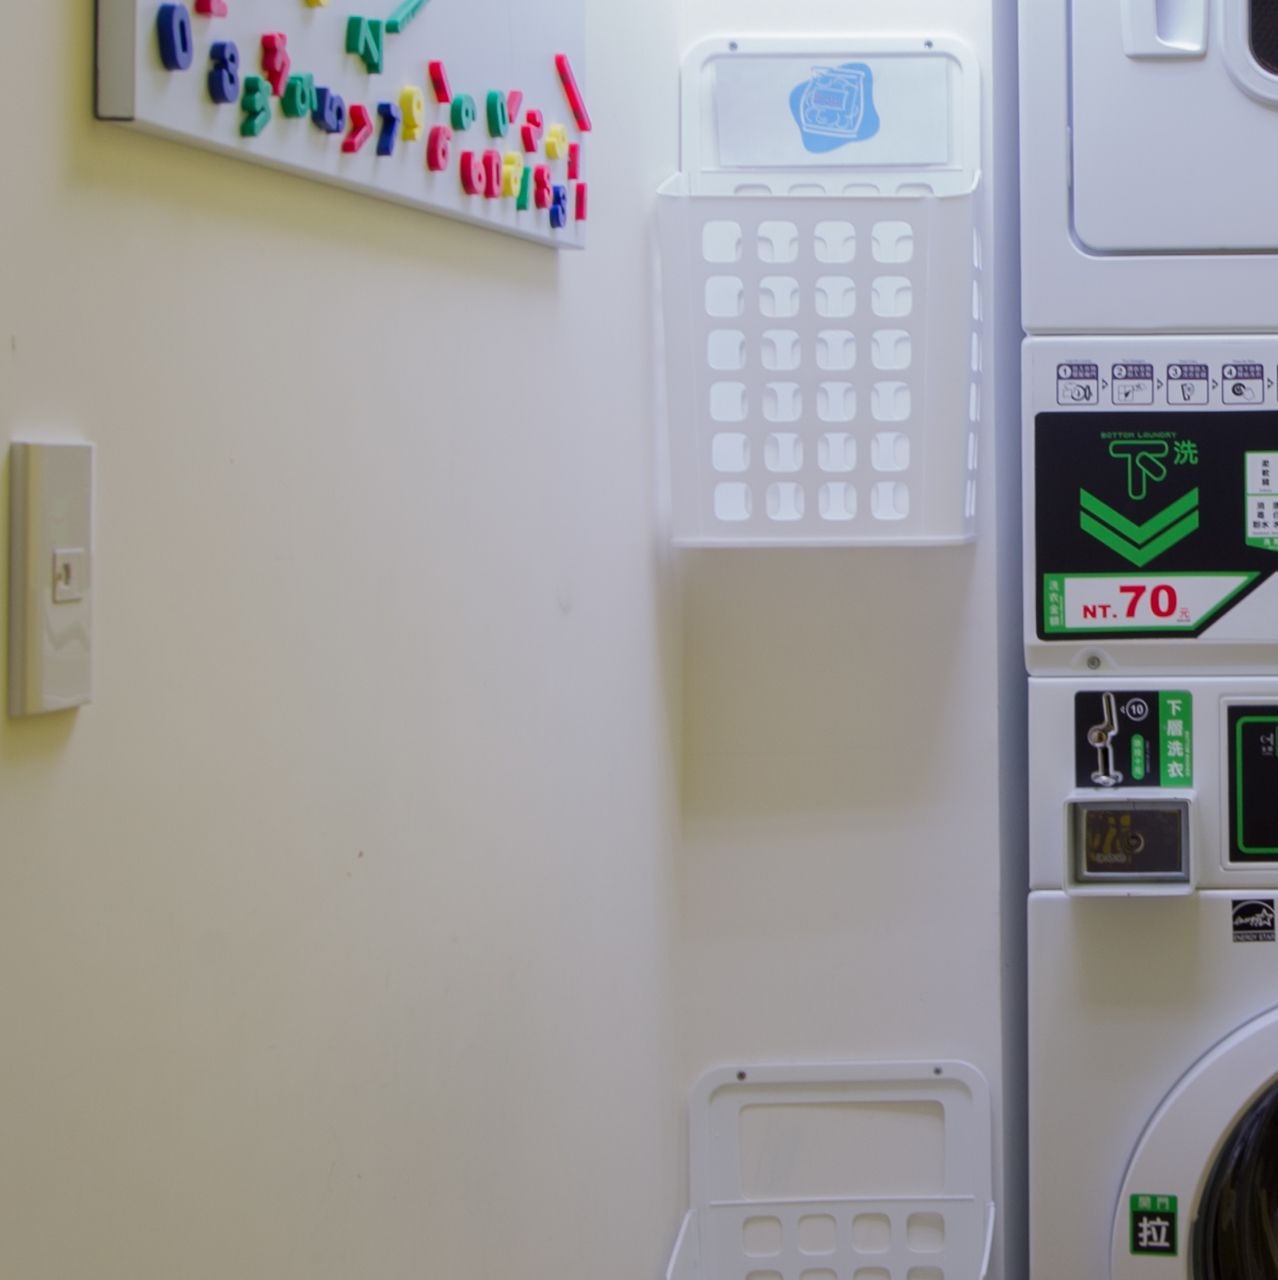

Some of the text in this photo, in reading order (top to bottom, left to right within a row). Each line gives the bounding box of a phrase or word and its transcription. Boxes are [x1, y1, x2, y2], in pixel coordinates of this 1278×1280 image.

[1166, 699, 1184, 778] 下層洗衣
[1138, 1215, 1170, 1248] 拉
